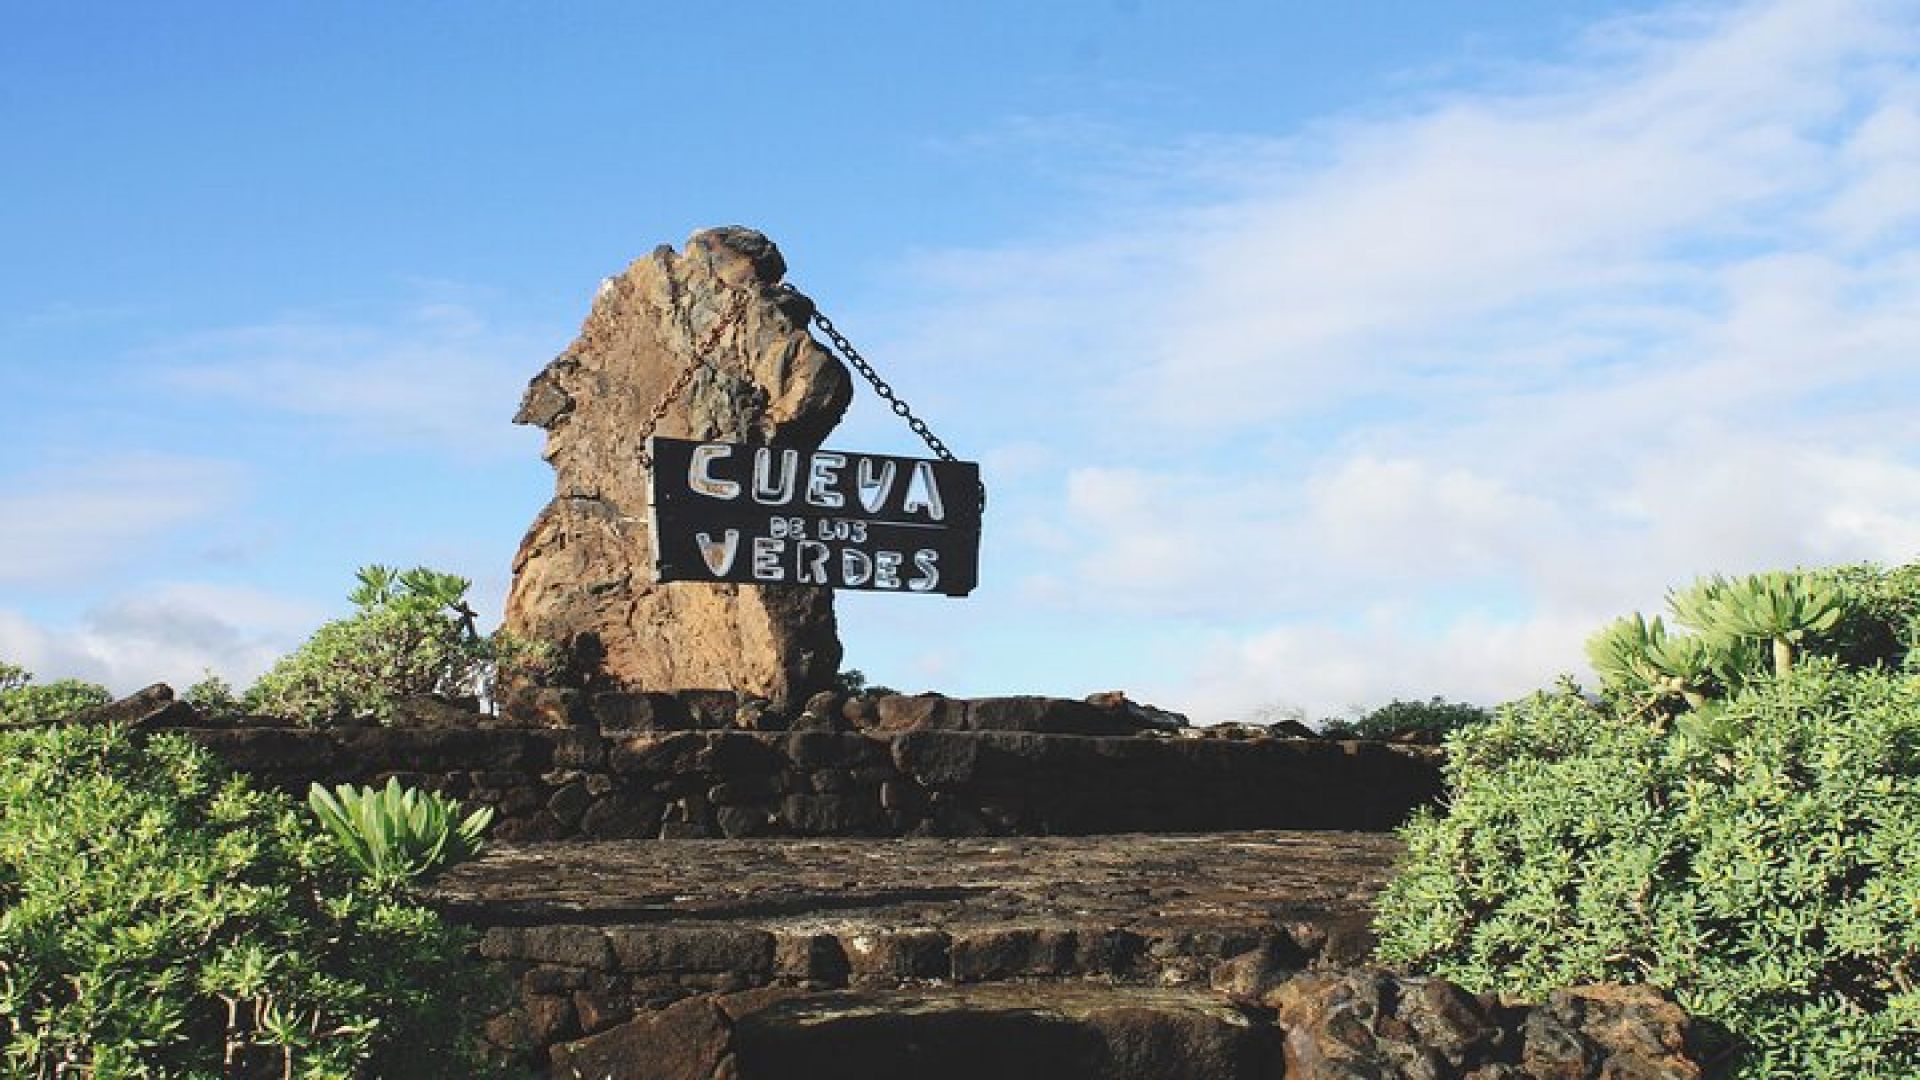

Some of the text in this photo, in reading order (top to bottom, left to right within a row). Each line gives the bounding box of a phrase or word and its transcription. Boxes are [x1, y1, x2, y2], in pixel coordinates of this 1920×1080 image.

[688, 444, 945, 520] CUEVA
[695, 528, 940, 591] VERDES
[769, 516, 868, 542] DE LOS
